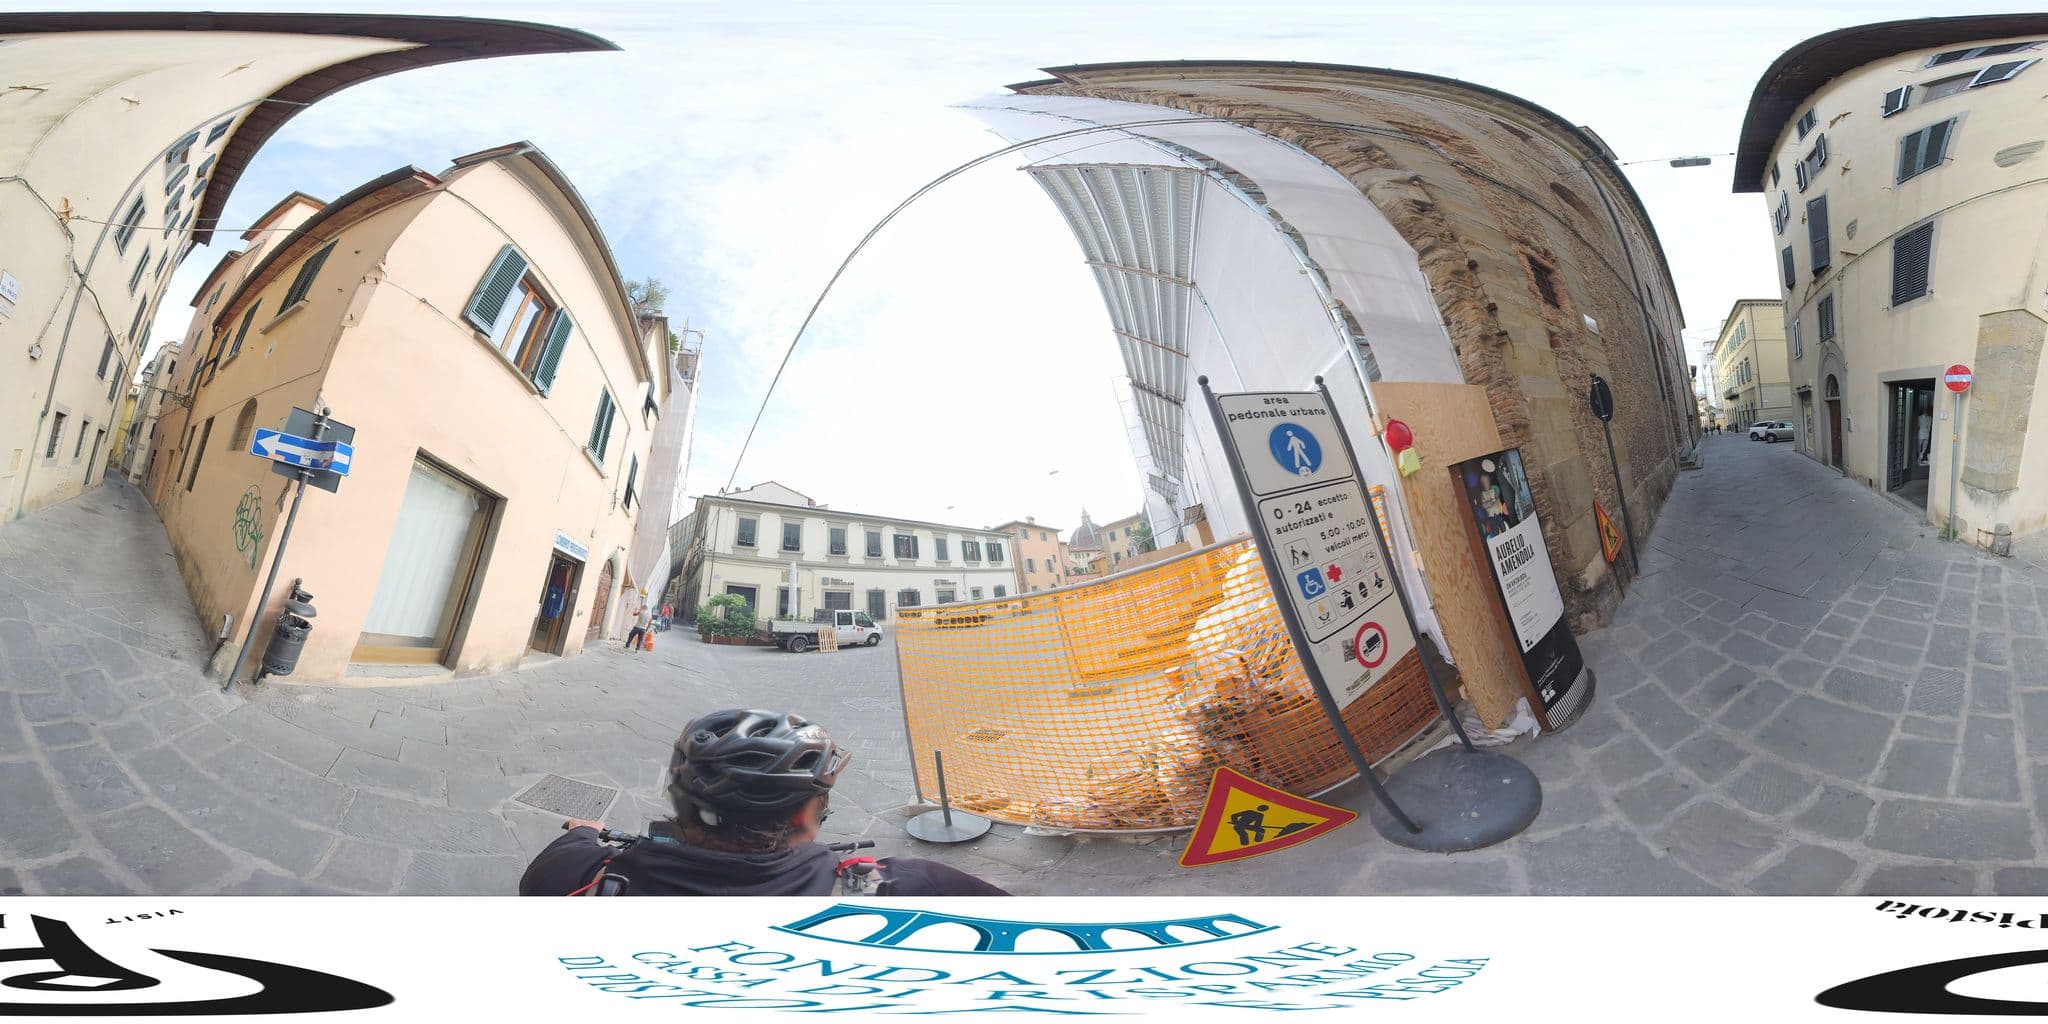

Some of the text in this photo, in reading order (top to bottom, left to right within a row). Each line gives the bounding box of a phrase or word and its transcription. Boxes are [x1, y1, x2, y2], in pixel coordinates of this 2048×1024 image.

[1263, 397, 1290, 405] area
[1228, 407, 1327, 422] pedonale urbana
[1273, 508, 1284, 520] 0
[1294, 501, 1312, 515] 24
[1317, 493, 1349, 507] eccetto
[1275, 512, 1326, 535] autorizzati
[1320, 527, 1341, 540] 5.00
[1346, 518, 1366, 531] 10.00
[1325, 530, 1370, 553] veicoli merci
[1496, 533, 1525, 561] AURELIO
[1501, 543, 1535, 577] AMENDOLA
